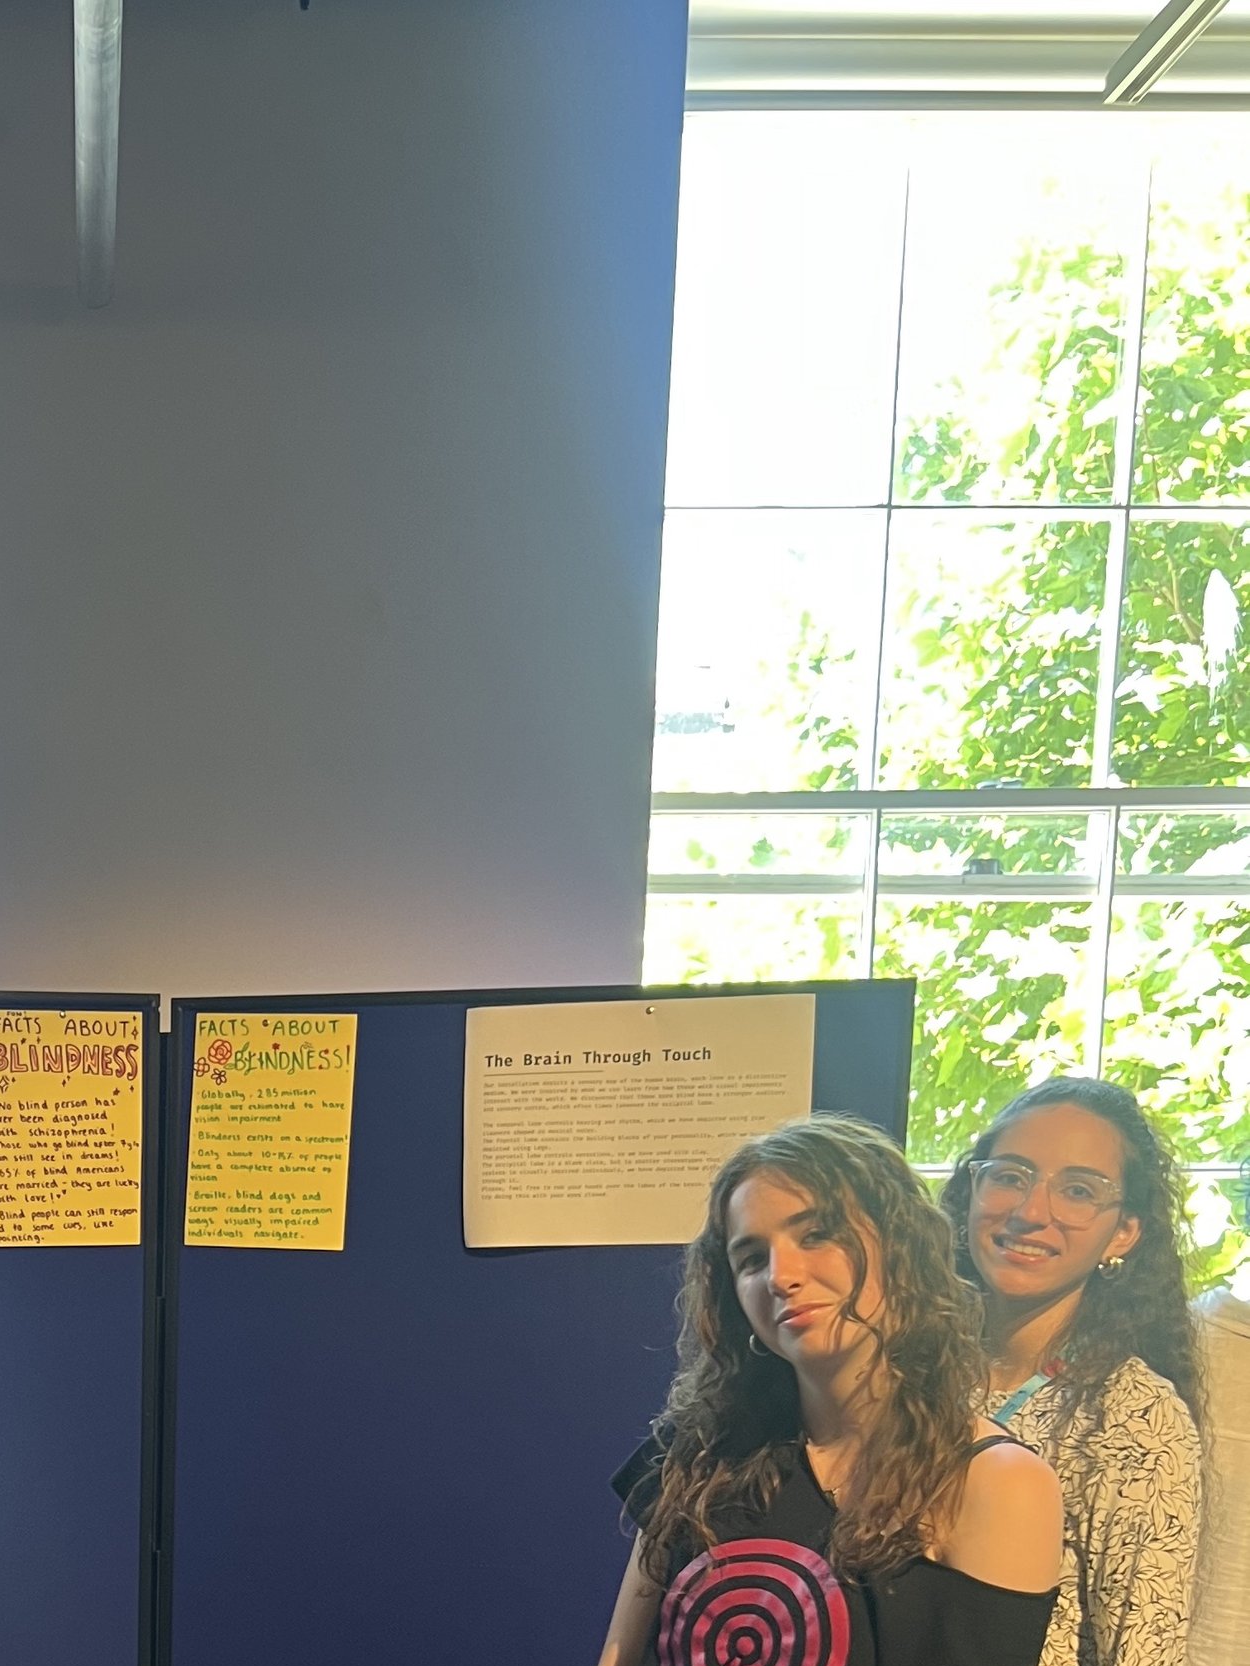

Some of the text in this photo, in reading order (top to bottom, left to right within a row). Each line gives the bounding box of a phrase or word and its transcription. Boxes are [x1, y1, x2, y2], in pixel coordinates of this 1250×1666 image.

[64, 1019, 129, 1038] ABOUT
[199, 1019, 340, 1036] FACTS ABOUT
[484, 1047, 711, 1068] The Brain Through Touch
[281, 1088, 317, 1098] million
[18, 1100, 48, 1111] blind
[54, 1099, 88, 1112] person
[95, 1097, 116, 1106] has
[196, 1103, 222, 1113] people
[322, 1100, 346, 1110] have
[20, 1114, 44, 1123] been
[52, 1110, 108, 1127] diagnosed
[194, 1115, 282, 1125] vision impairment
[198, 1131, 241, 1141] Blindness
[28, 1140, 48, 1149] who
[52, 1143, 62, 1152] go
[65, 1140, 89, 1148] blind
[93, 1140, 116, 1149] after
[13, 1151, 34, 1161] still
[41, 1153, 55, 1162] see
[61, 1151, 73, 1160] in
[198, 1149, 220, 1160] Only
[314, 1152, 342, 1162] people
[26, 1169, 36, 1179] of
[43, 1165, 68, 1175] blind
[279, 1165, 316, 1173] absence
[16, 1179, 58, 1190] married
[71, 1180, 92, 1192] they
[115, 1179, 139, 1189] lucky
[236, 1189, 263, 1201] blind
[269, 1192, 297, 1204] dogs
[302, 1191, 321, 1201] and
[0, 1209, 25, 1220] Blind
[31, 1208, 60, 1221] people
[87, 1208, 105, 1217] still
[226, 1204, 262, 1214] readers
[291, 1207, 332, 1215] common
[33, 1223, 55, 1232] some
[224, 1217, 262, 1228] visually
[270, 1217, 320, 1228] impaired
[188, 1230, 243, 1239] individuals
